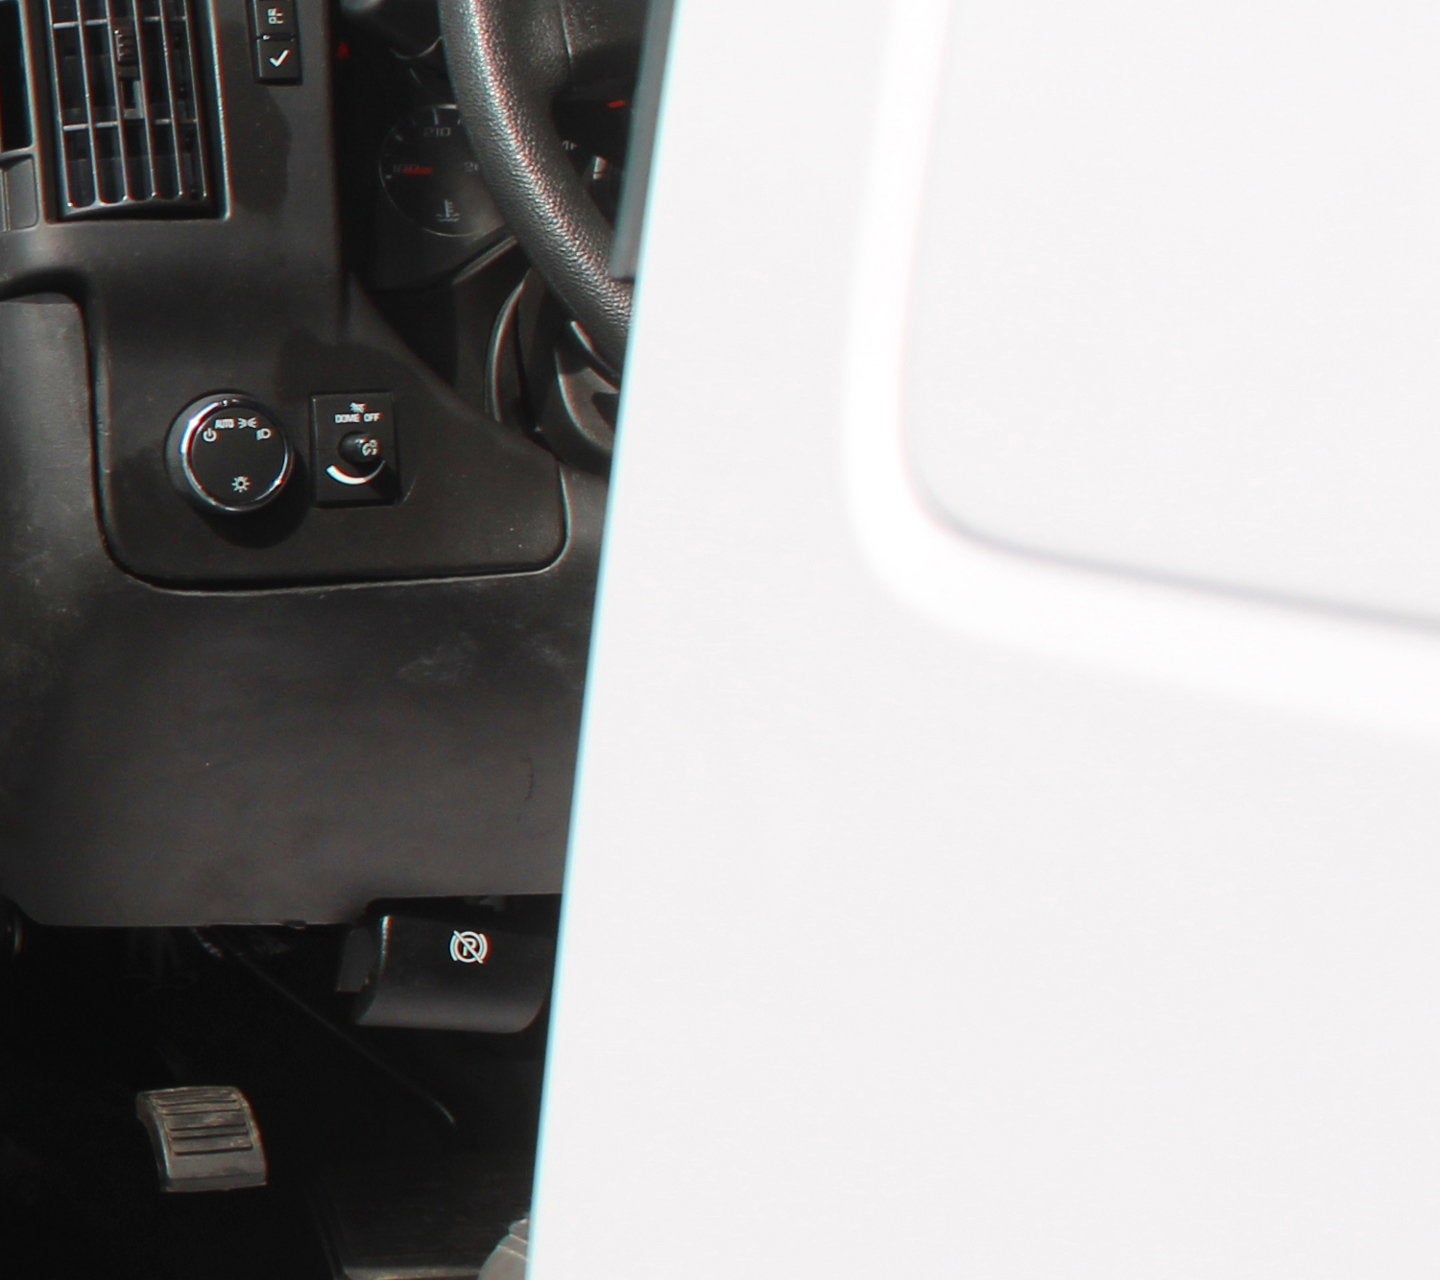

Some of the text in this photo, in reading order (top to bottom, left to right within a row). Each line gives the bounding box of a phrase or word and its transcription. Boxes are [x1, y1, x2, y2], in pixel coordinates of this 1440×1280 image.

[214, 418, 234, 429] AUTO
[335, 412, 381, 424] DOME OFF
